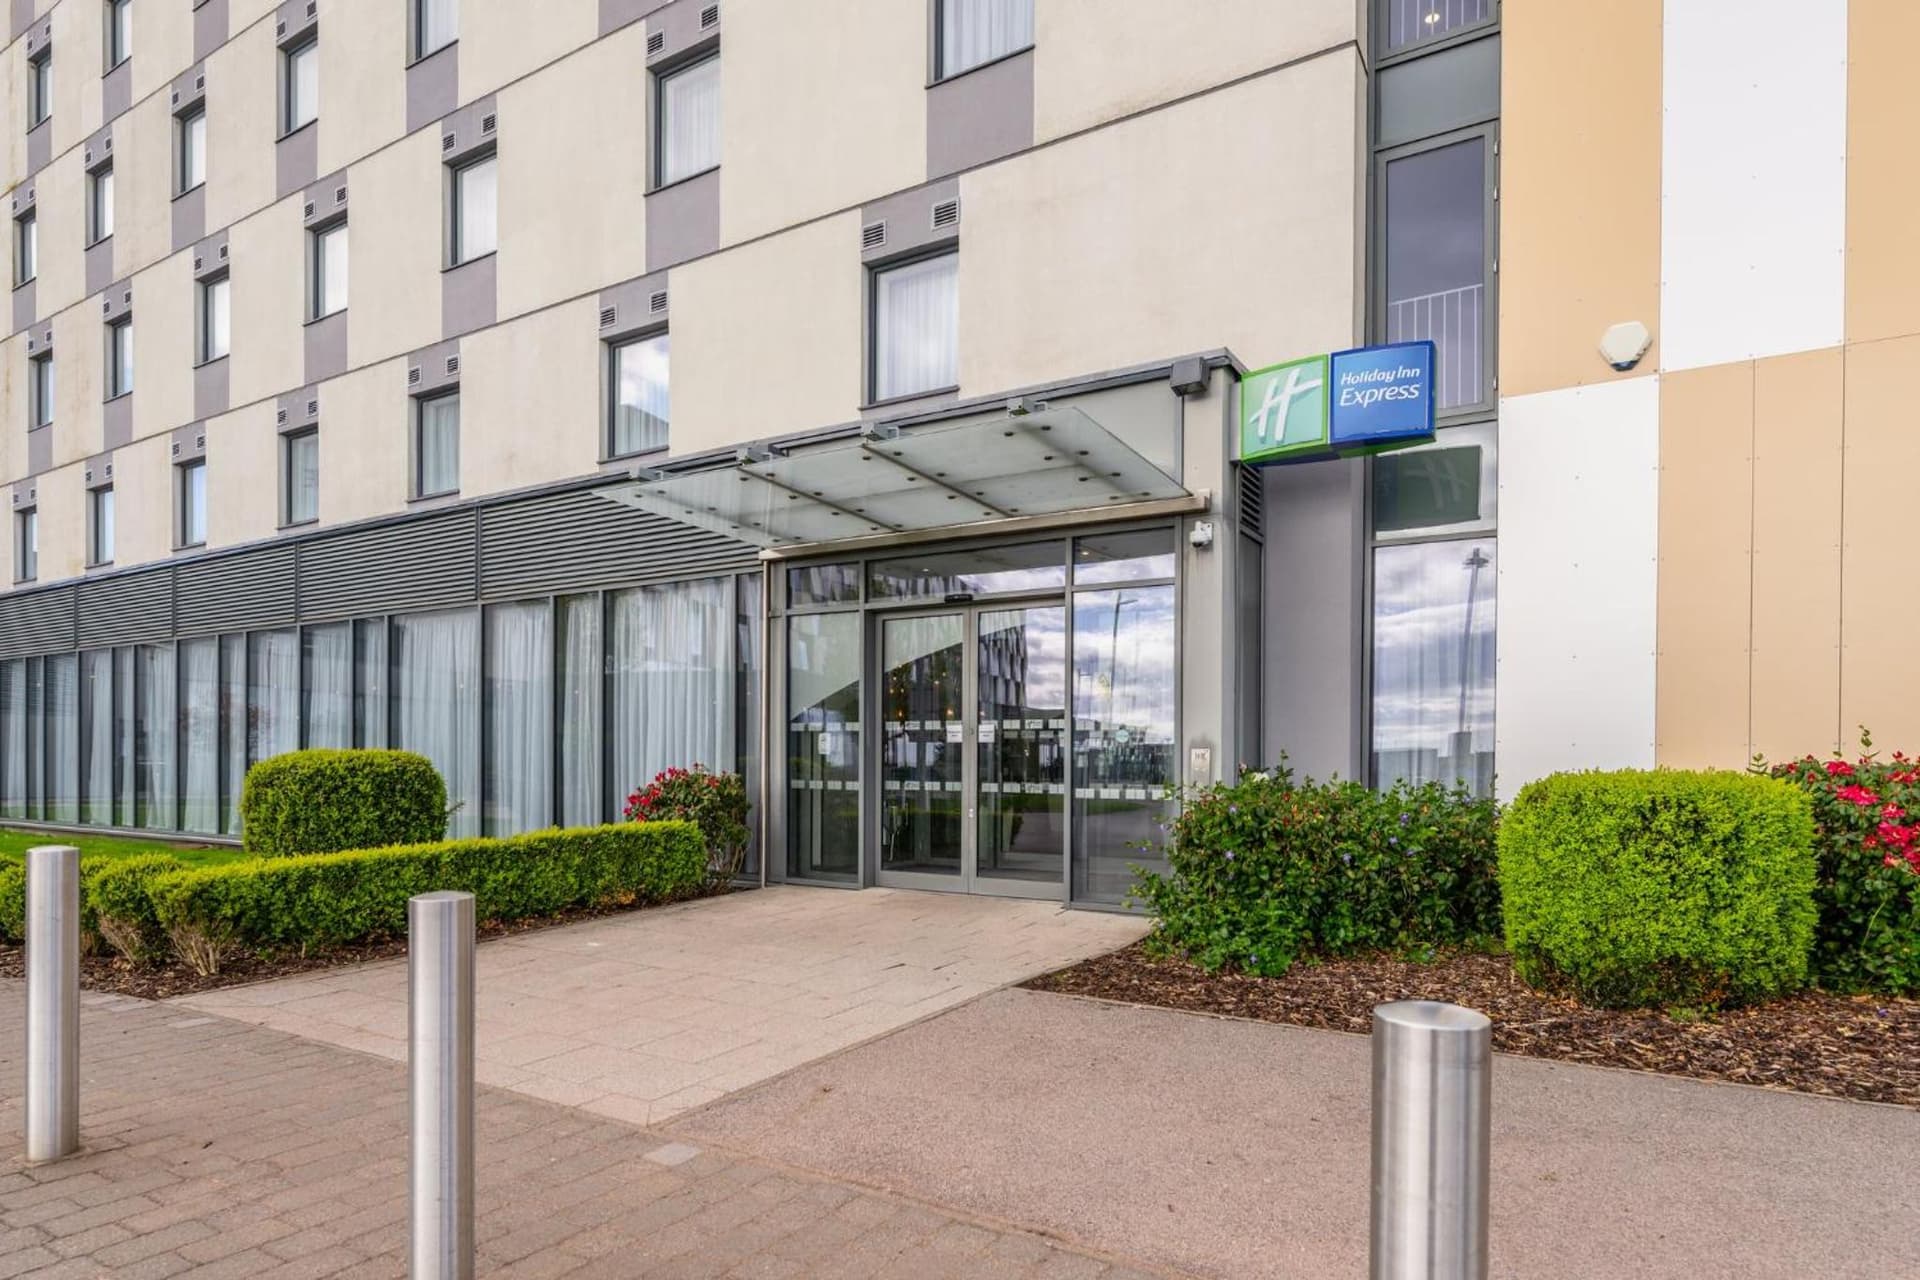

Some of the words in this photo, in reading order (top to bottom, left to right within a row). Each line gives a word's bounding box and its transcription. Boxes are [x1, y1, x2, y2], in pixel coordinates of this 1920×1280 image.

[1341, 368, 1396, 385] Holiday
[1397, 366, 1420, 379] Inn
[1340, 384, 1420, 408] Express
